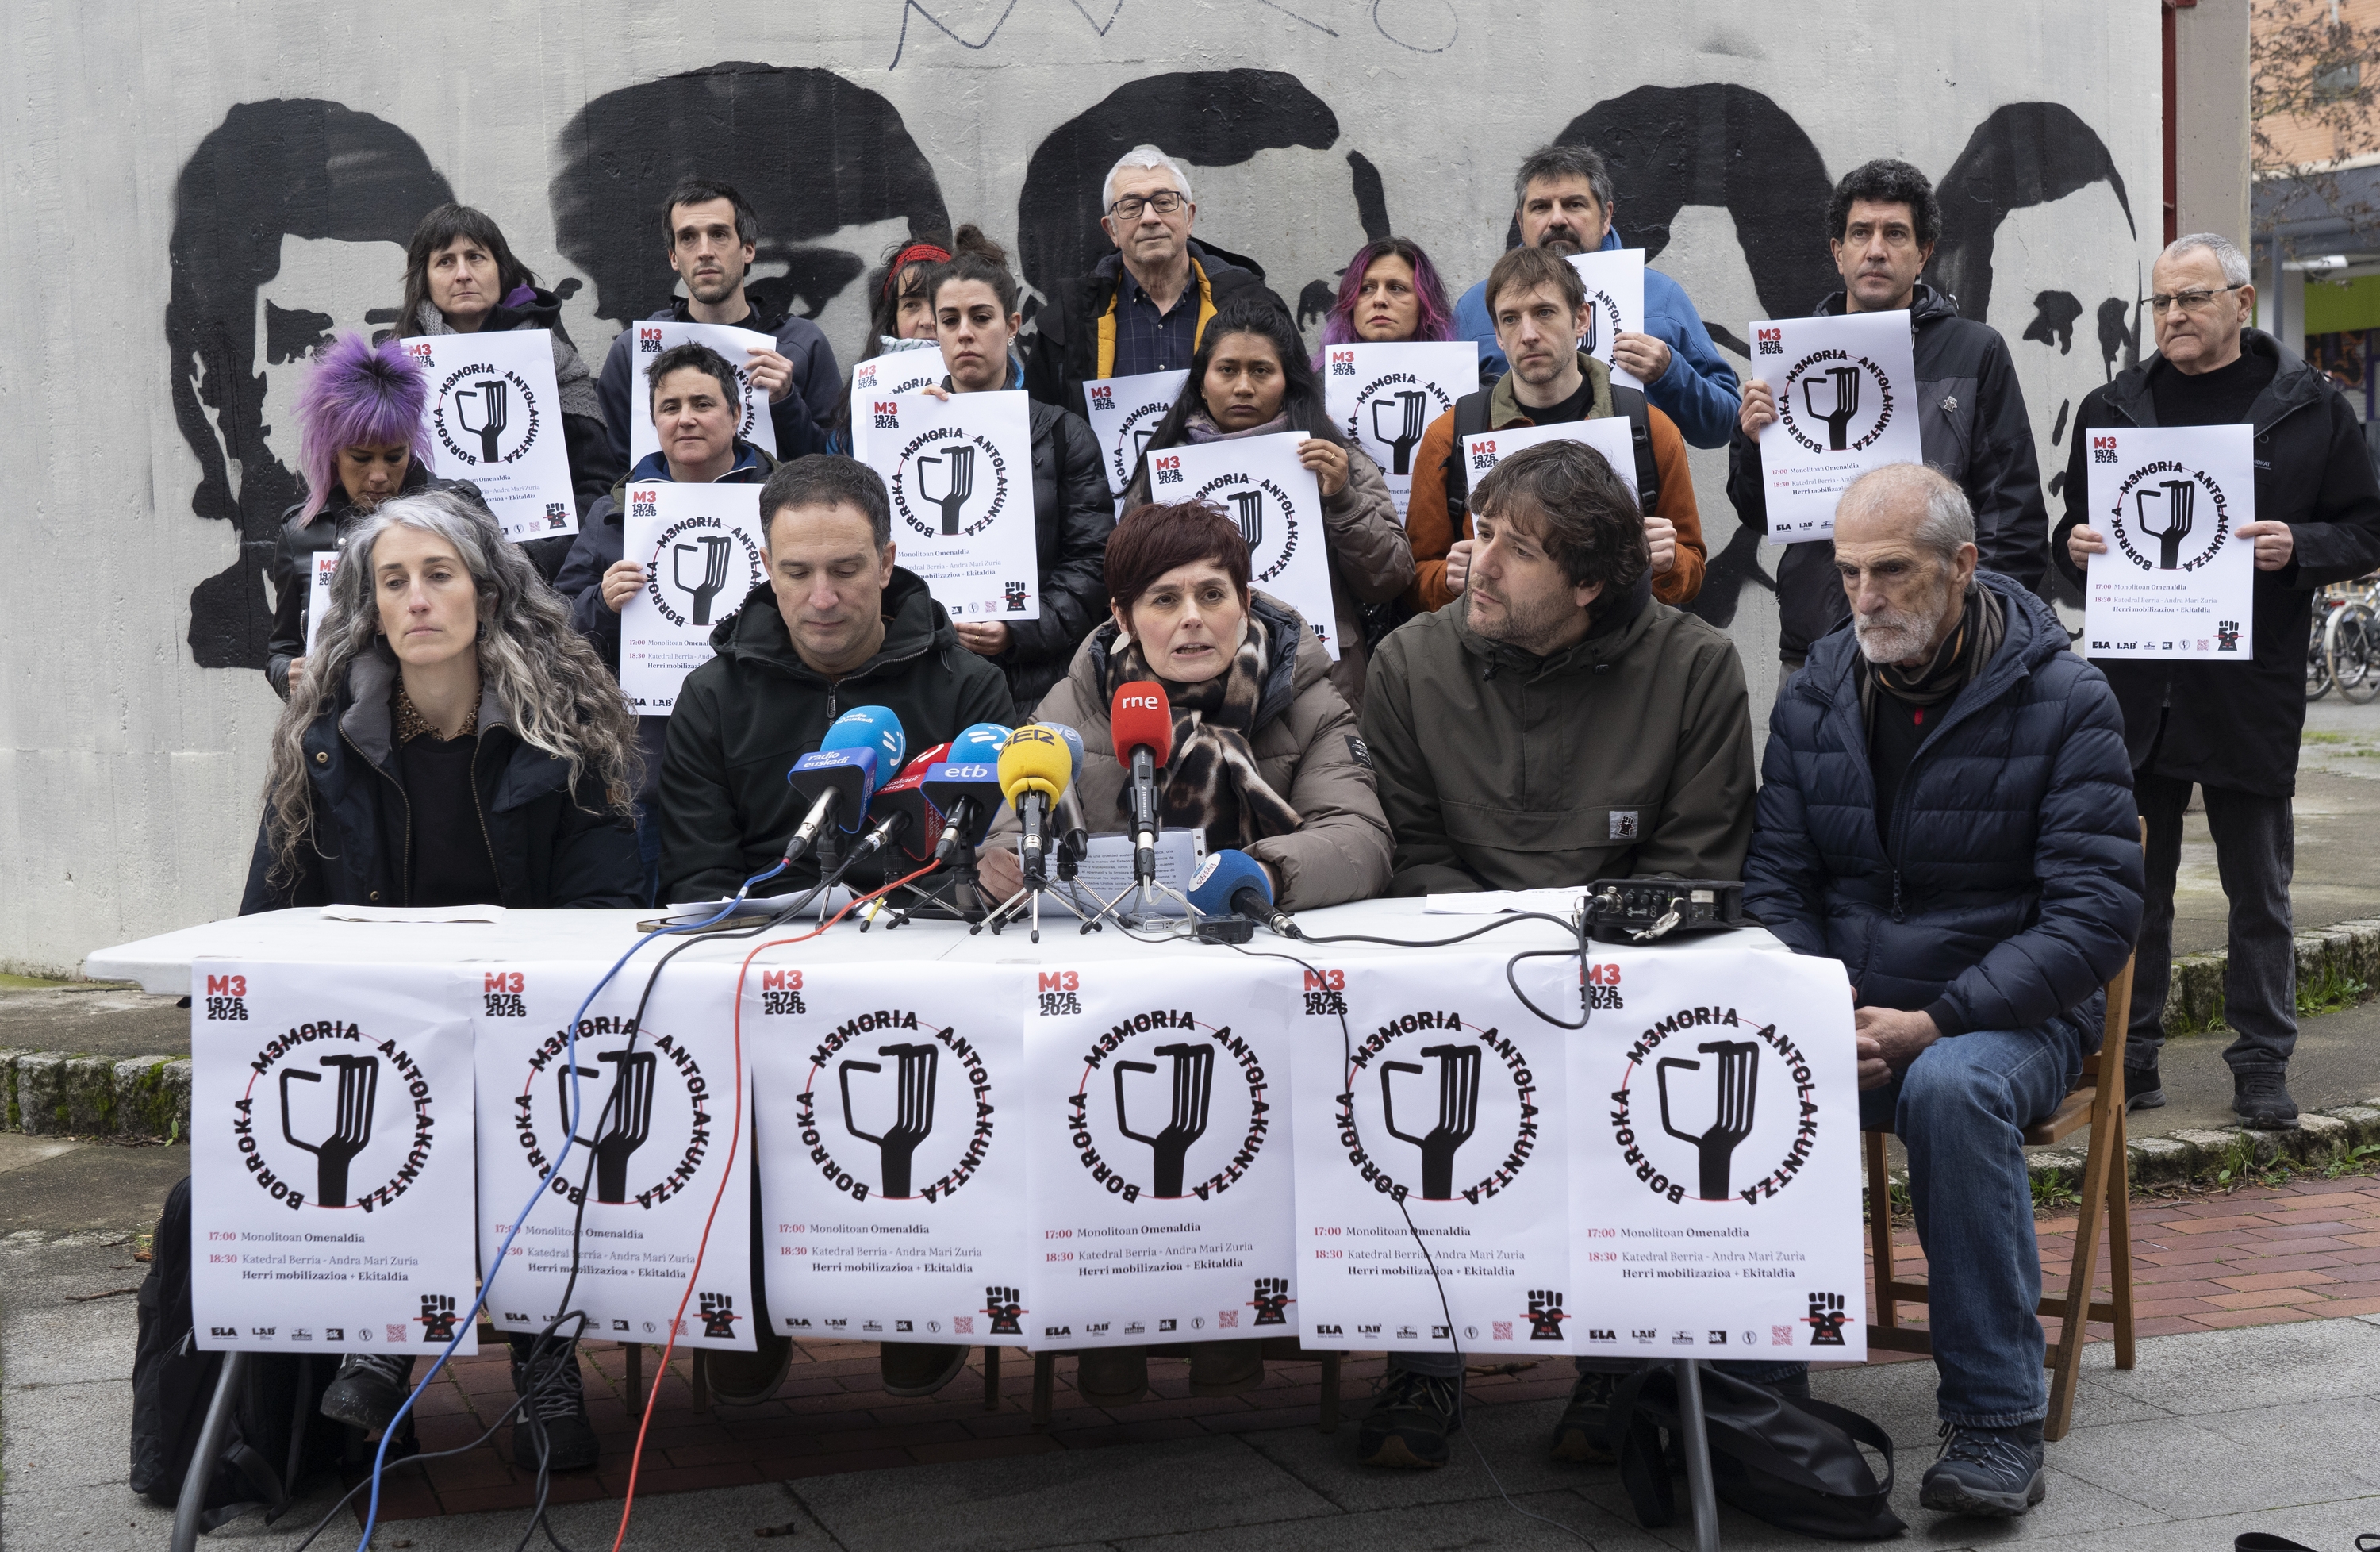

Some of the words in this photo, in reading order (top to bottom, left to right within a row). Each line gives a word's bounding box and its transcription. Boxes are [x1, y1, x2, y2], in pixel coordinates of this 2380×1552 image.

[641, 329, 662, 340] M3
[1758, 328, 1781, 341] M3
[1332, 351, 1354, 363] M3
[1786, 349, 1847, 382] M3MORIA
[440, 363, 495, 395] M3MORIA
[1357, 373, 1416, 405] M3MORIA
[1091, 386, 1111, 398] M3
[1092, 398, 1111, 406] 1976
[874, 402, 897, 414] M3
[1852, 357, 1894, 451] ANTOLAKUNTZA
[504, 371, 539, 464] ANTOLAKUNTZA
[874, 415, 896, 424] 1976
[1779, 394, 1822, 454] BORROKA
[433, 407, 476, 466] BORROKA
[900, 428, 963, 461] M3MORIA
[2094, 437, 2117, 449] M3
[1472, 441, 1496, 455] M3
[1156, 456, 1180, 470] M3
[1157, 470, 1180, 478] 1976
[1159, 475, 1183, 484] 2026
[2120, 461, 2182, 494] M3MORIA
[965, 436, 1008, 536] ANTOLAKUNTZA
[633, 491, 656, 502] M3
[892, 474, 935, 538] BORROKA
[1258, 479, 1298, 583] ANTOLAKUNTZA
[2183, 470, 2228, 572] ANTOLAKUNTZA
[657, 517, 722, 548] M3MORIA
[2112, 507, 2152, 571] BORROKA
[2117, 641, 2136, 650] LAB
[1123, 697, 1158, 709] rne
[999, 729, 1054, 761] SER
[804, 757, 850, 767] euskadi
[945, 765, 988, 778] etb
[887, 775, 920, 786] uskadi
[485, 973, 524, 993] M3
[763, 970, 803, 990] M3
[1038, 971, 1079, 991] M3
[1304, 970, 1345, 991] M3
[1580, 964, 1621, 985] M3
[208, 975, 247, 996] M3
[206, 997, 244, 1011] 1976
[484, 994, 522, 1006] 1976
[762, 992, 800, 1005] 1976
[765, 1002, 806, 1015] 2026
[1038, 993, 1077, 1006] 1976
[1303, 993, 1342, 1005] 1976
[1306, 1002, 1348, 1015] 2026
[208, 1008, 248, 1020] 2026
[486, 1005, 526, 1017] 2026
[1040, 1004, 1081, 1016] 2026
[810, 1010, 918, 1069] M3MORIA
[1084, 1009, 1196, 1070] M3MORIA
[1350, 1011, 1461, 1070] M3MORIA
[1626, 1007, 1739, 1066] M3MORIA
[251, 1020, 360, 1075] M3MORIA
[635, 1035, 711, 1210] ANTOLAKUNTZA
[920, 1026, 994, 1204] ANTOLAKUNTZA
[1192, 1026, 1269, 1201] ANTOLAKUNTZA
[1461, 1028, 1538, 1205] ANTOLAKUNTZA
[1740, 1024, 1818, 1206] ANTOLAKUNTZA
[357, 1039, 434, 1213] ANTOLAKUNTZA
[234, 1097, 305, 1210] BORROKA
[797, 1091, 869, 1202] BORROKA
[1069, 1092, 1141, 1204] BORROKA
[1335, 1092, 1409, 1204] BORROKA
[1610, 1089, 1685, 1204] BORROKA
[209, 1232, 236, 1242] 17:00
[241, 1232, 301, 1242] Monolitoan
[305, 1233, 365, 1243] Omenaldia
[1046, 1229, 1072, 1239] 17:00
[1077, 1226, 1138, 1238] Monolitoan
[1141, 1223, 1201, 1234] Omenaldia
[1587, 1228, 1615, 1238] 17:00
[1621, 1228, 1683, 1238] Monolitoan
[1687, 1228, 1749, 1238] Omenaldia
[209, 1254, 236, 1264] 18:30
[243, 1254, 286, 1265] Katedral
[289, 1255, 321, 1265] Berria
[329, 1256, 361, 1266] Andra
[364, 1256, 387, 1266] Mari
[390, 1256, 418, 1266] Zuria
[1046, 1252, 1073, 1262] 18:30
[1079, 1248, 1123, 1261] Katedral
[1126, 1247, 1157, 1258] Berria
[1165, 1245, 1196, 1256] Andra
[1200, 1243, 1223, 1254] Mari
[1226, 1242, 1253, 1253] Zuria
[243, 1270, 273, 1280] Herri
[276, 1271, 347, 1281] mobilizazioa
[359, 1272, 409, 1282] Ekitaldia
[1079, 1266, 1109, 1277] Herri
[1112, 1262, 1182, 1274] mobilizazioa
[1194, 1258, 1243, 1270] Ekitaldia
[1622, 1269, 1654, 1278] Herri
[1657, 1269, 1731, 1279] mobilizazioa
[1743, 1269, 1795, 1279] Ekitaldia
[211, 1327, 237, 1337] ELA
[252, 1327, 274, 1336] LAB
[1046, 1327, 1071, 1337] ELA
[1086, 1323, 1109, 1333] LAB
